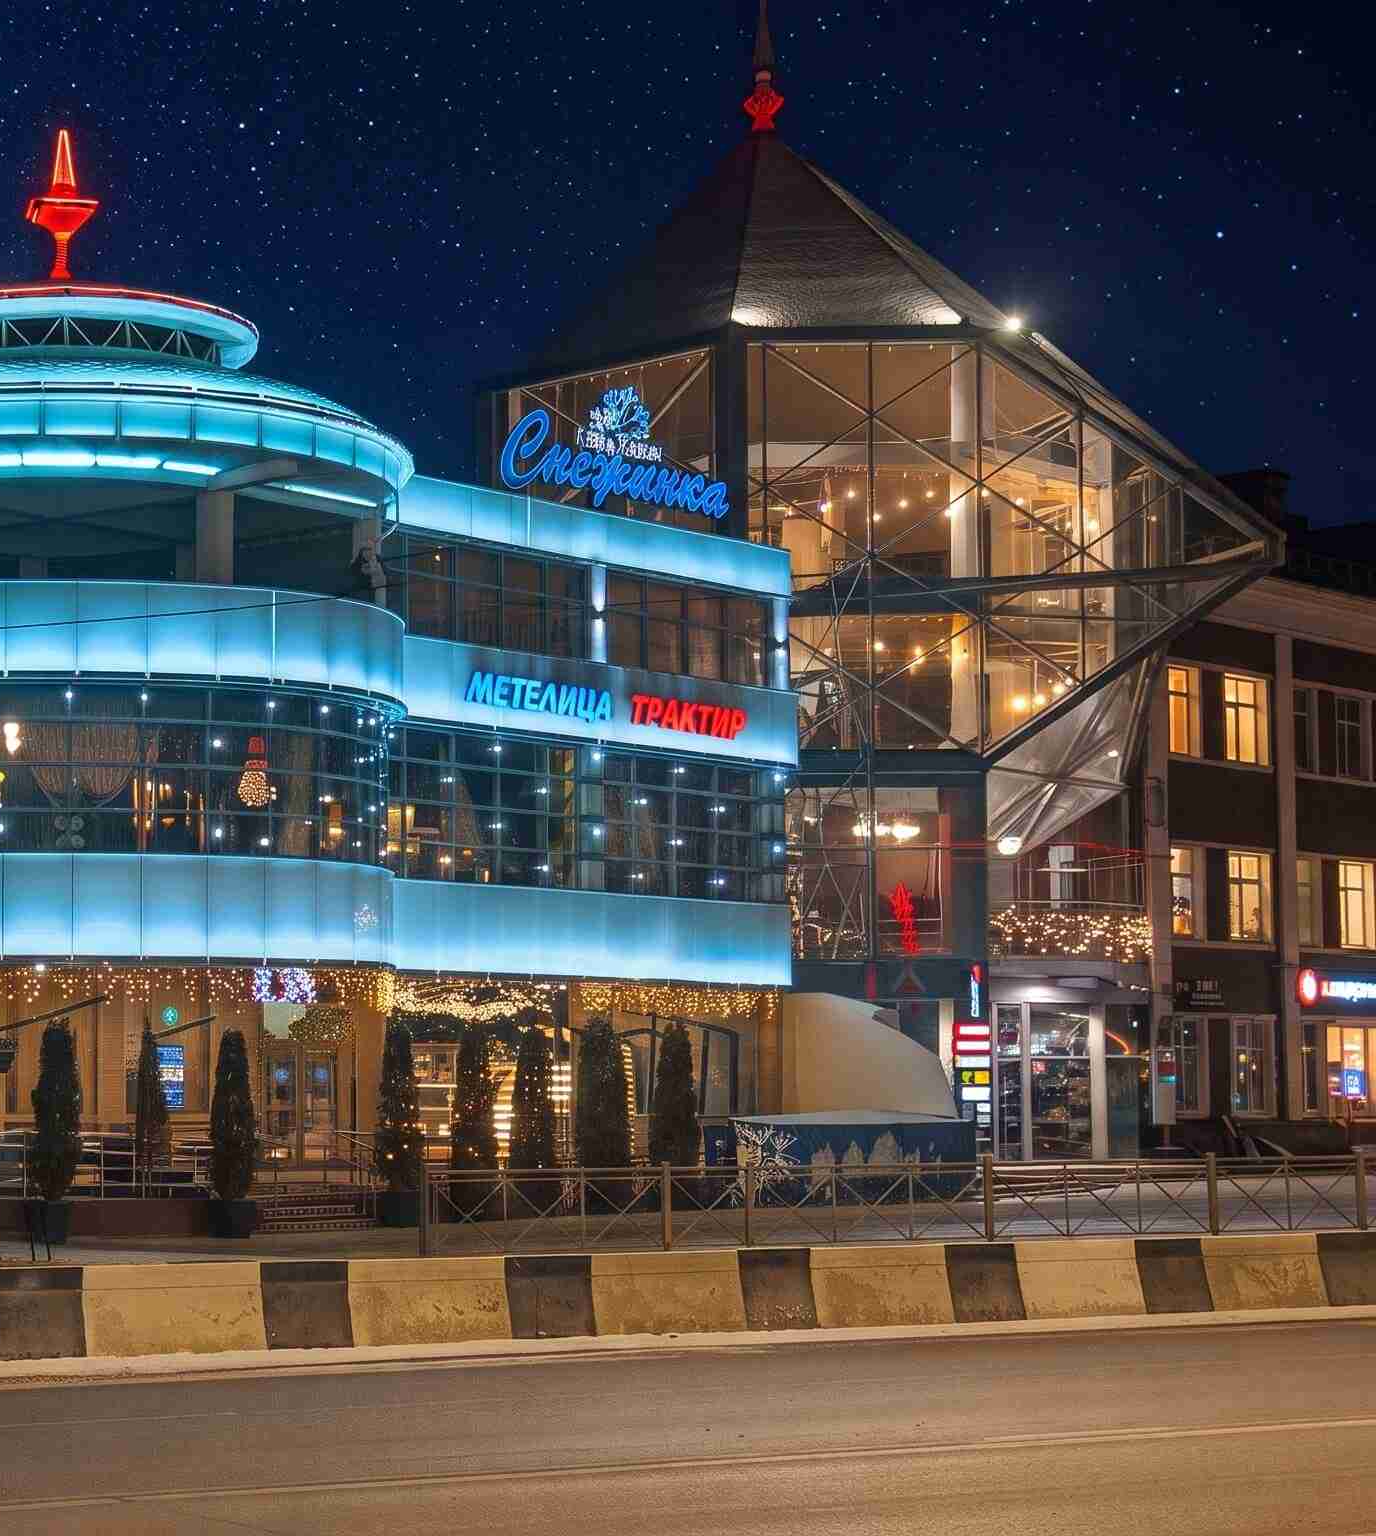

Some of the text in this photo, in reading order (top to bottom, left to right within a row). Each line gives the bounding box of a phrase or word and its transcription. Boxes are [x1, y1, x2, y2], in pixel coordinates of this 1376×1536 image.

[501, 409, 730, 519] Снежинка
[465, 671, 613, 723] МЕТЕЛИЦА
[630, 693, 747, 740] ТРАКТИР
